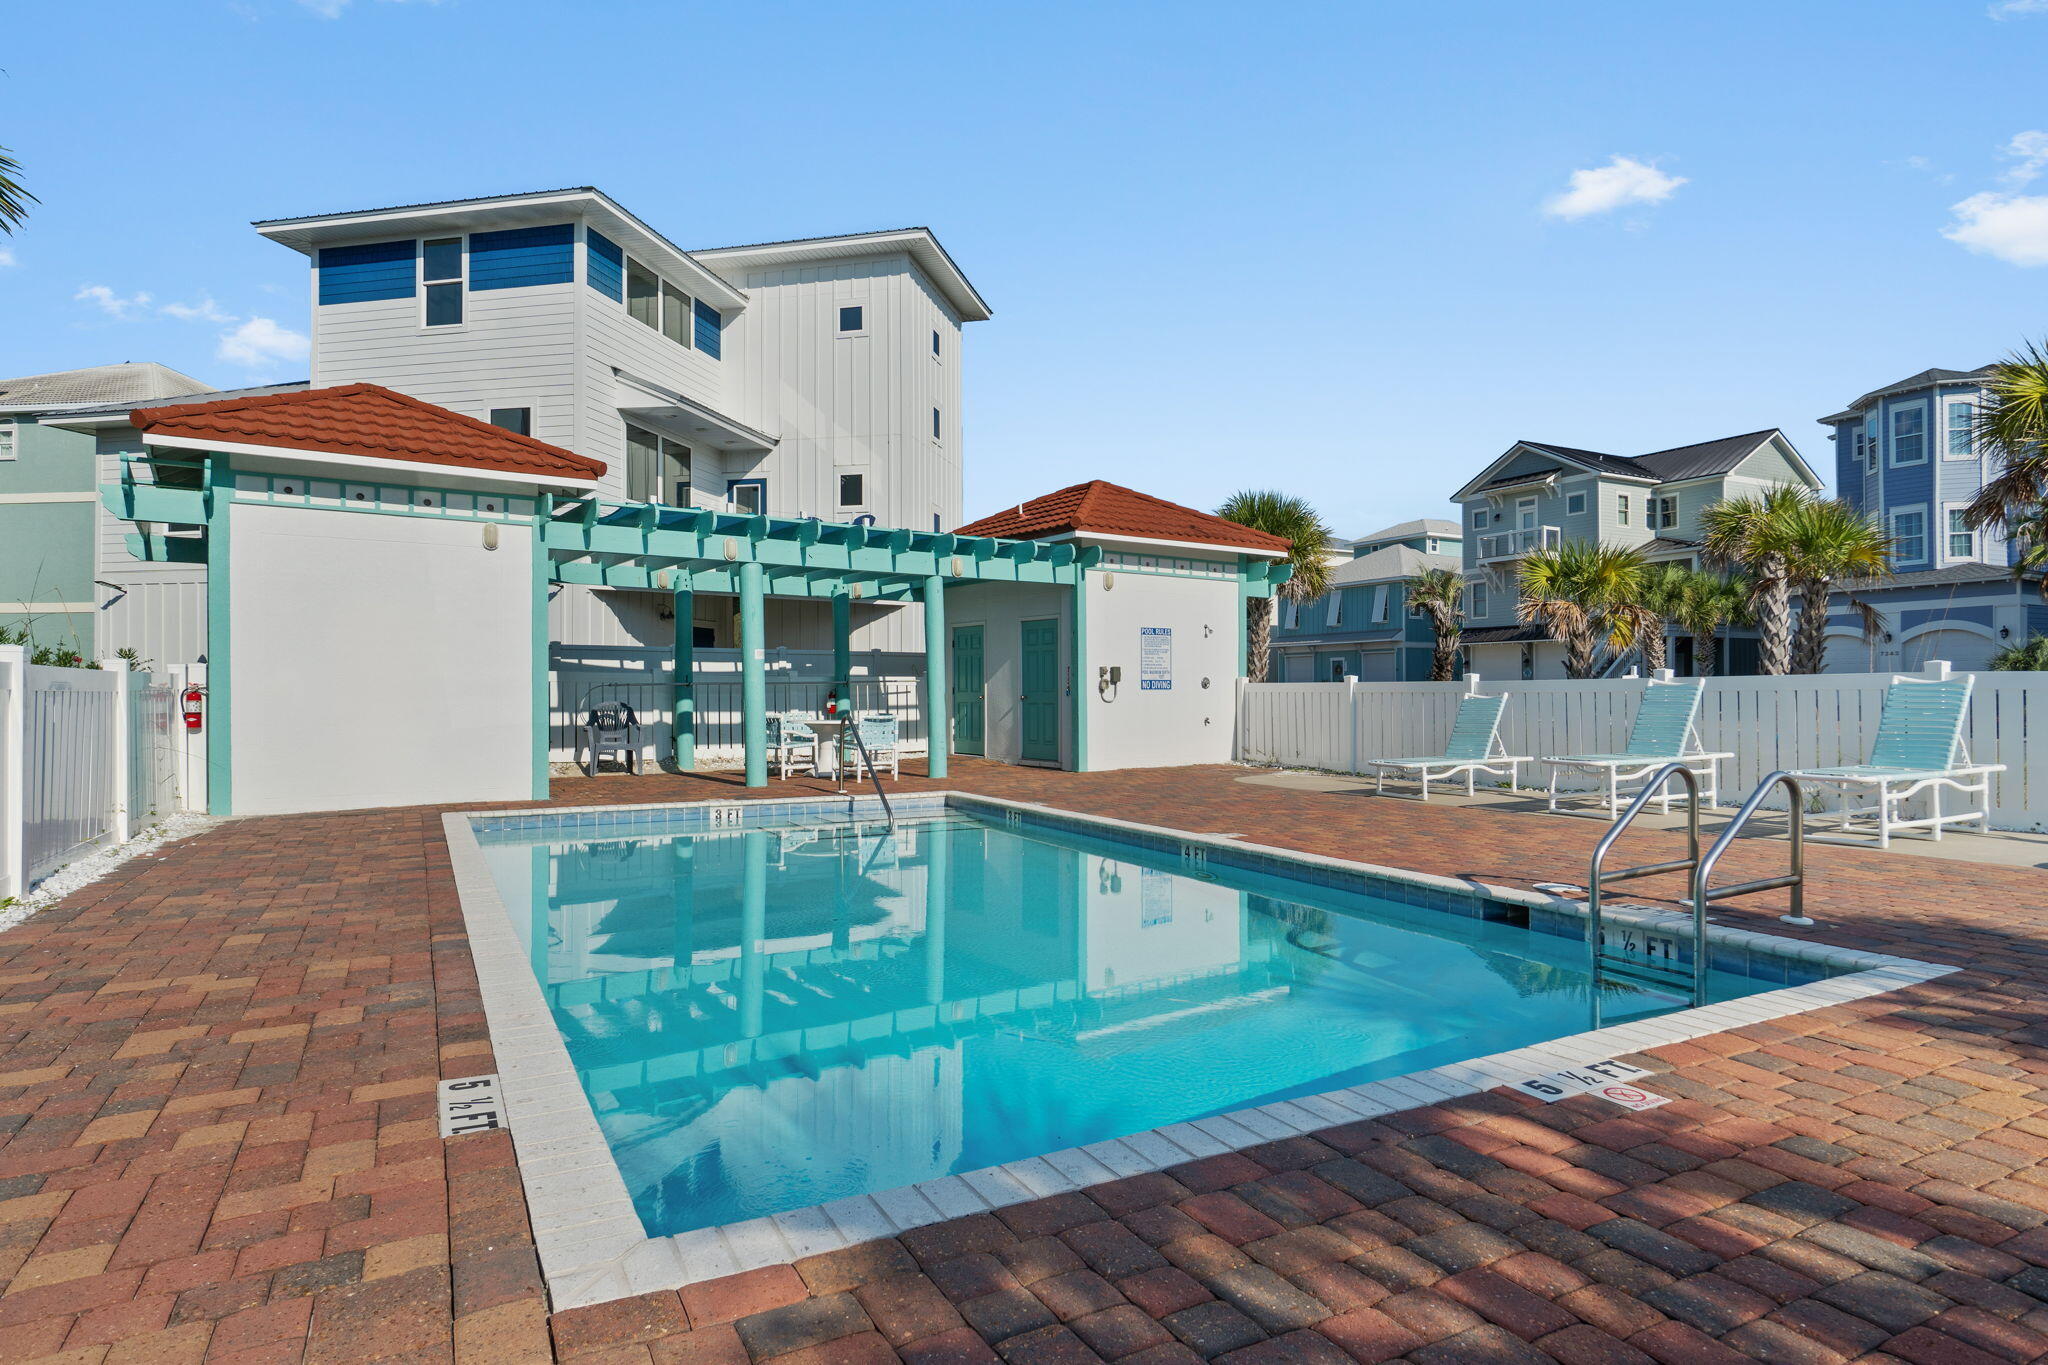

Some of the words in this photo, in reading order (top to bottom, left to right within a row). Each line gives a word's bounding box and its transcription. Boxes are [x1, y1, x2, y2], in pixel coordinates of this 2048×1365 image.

[1156, 628, 1171, 636] RULES
[1142, 681, 1150, 689] NO
[1151, 681, 1170, 689] DIVING
[715, 808, 722, 819] 3
[1184, 845, 1191, 858] 4
[448, 1079, 492, 1091] 5
[1521, 1079, 1564, 1095] 5
